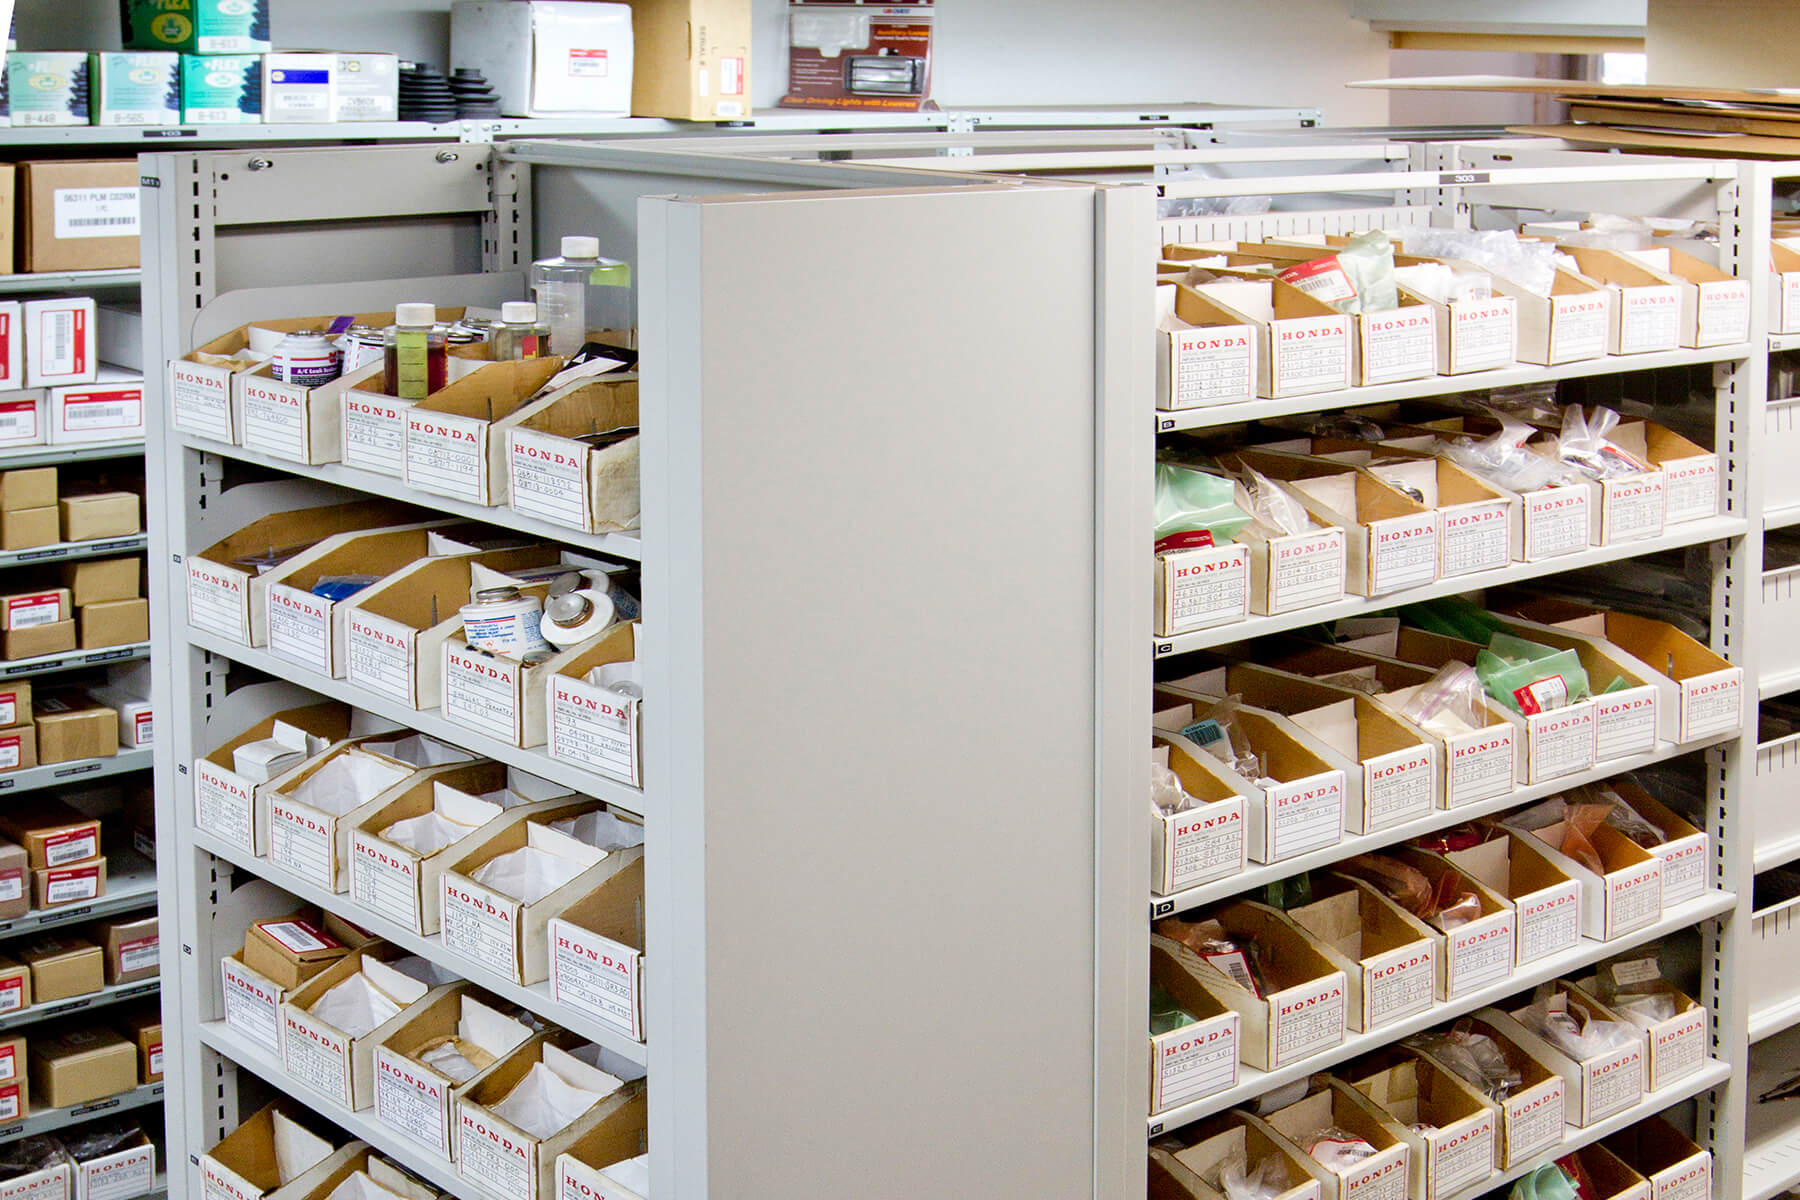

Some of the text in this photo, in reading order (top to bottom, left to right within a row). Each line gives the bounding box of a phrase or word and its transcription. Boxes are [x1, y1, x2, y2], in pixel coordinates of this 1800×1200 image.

[1630, 296, 1675, 305] HONDA
[1706, 291, 1745, 300] HONDA
[1459, 308, 1509, 320] HONDA
[1560, 302, 1603, 314] HONDA
[1282, 327, 1343, 340] HONDA
[1371, 317, 1429, 331] HONDA
[1183, 337, 1247, 351] HONDA
[176, 372, 223, 389] HONDA
[248, 388, 299, 406] HONDA
[350, 402, 401, 420] HOND
[410, 421, 476, 443] HONDA
[515, 444, 579, 468] HONDA
[1669, 466, 1714, 479] HONDA
[1614, 484, 1661, 498] HONDA
[1533, 496, 1584, 512] HONDA
[1448, 510, 1504, 527] HONDA
[1380, 526, 1433, 542] HONDA
[1280, 540, 1338, 558] HONDA
[1177, 559, 1242, 577] HONDA
[192, 569, 240, 592] HONDA
[272, 593, 323, 618] HONDA
[352, 623, 406, 649] HONDA
[1160, 644, 1172, 652] C
[450, 655, 512, 684] HONDA
[1690, 680, 1738, 696] HONDA
[557, 691, 627, 720] HONDA
[1600, 699, 1653, 715] HONDA
[1539, 715, 1591, 733] HONDA
[1456, 738, 1511, 757] HONDA
[1374, 758, 1428, 779] HONDA
[201, 773, 247, 800] HONDA
[1278, 785, 1338, 807] HONDA
[274, 807, 327, 835] HONDA
[1177, 812, 1240, 835] HONDA
[356, 843, 411, 875] HONDA
[1661, 845, 1703, 862] ONDA
[1615, 872, 1658, 892] HONDA
[447, 886, 510, 921] HONDA
[1160, 902, 1172, 912] D
[1526, 894, 1575, 916] HONDA
[1457, 927, 1508, 948] HONDA
[559, 937, 629, 974] HONDA
[1374, 954, 1430, 979] HONDA
[227, 972, 273, 1004] HONDA
[1281, 989, 1341, 1015] HONDA
[287, 1018, 342, 1053] HONDA
[1165, 1028, 1232, 1056] HONDA
[1659, 1022, 1702, 1044] HONDA
[1592, 1054, 1639, 1077] HONDA
[381, 1061, 438, 1098] HONDA
[1513, 1091, 1560, 1118] HONDA
[464, 1116, 526, 1159] HONDA
[1439, 1124, 1490, 1152] HONDA
[91, 1156, 148, 1174] HONDA
[1350, 1160, 1403, 1190] HONDA
[4, 1176, 62, 1197] HONDA
[207, 1170, 250, 1200] HOND
[1660, 1167, 1705, 1192] HONDA
